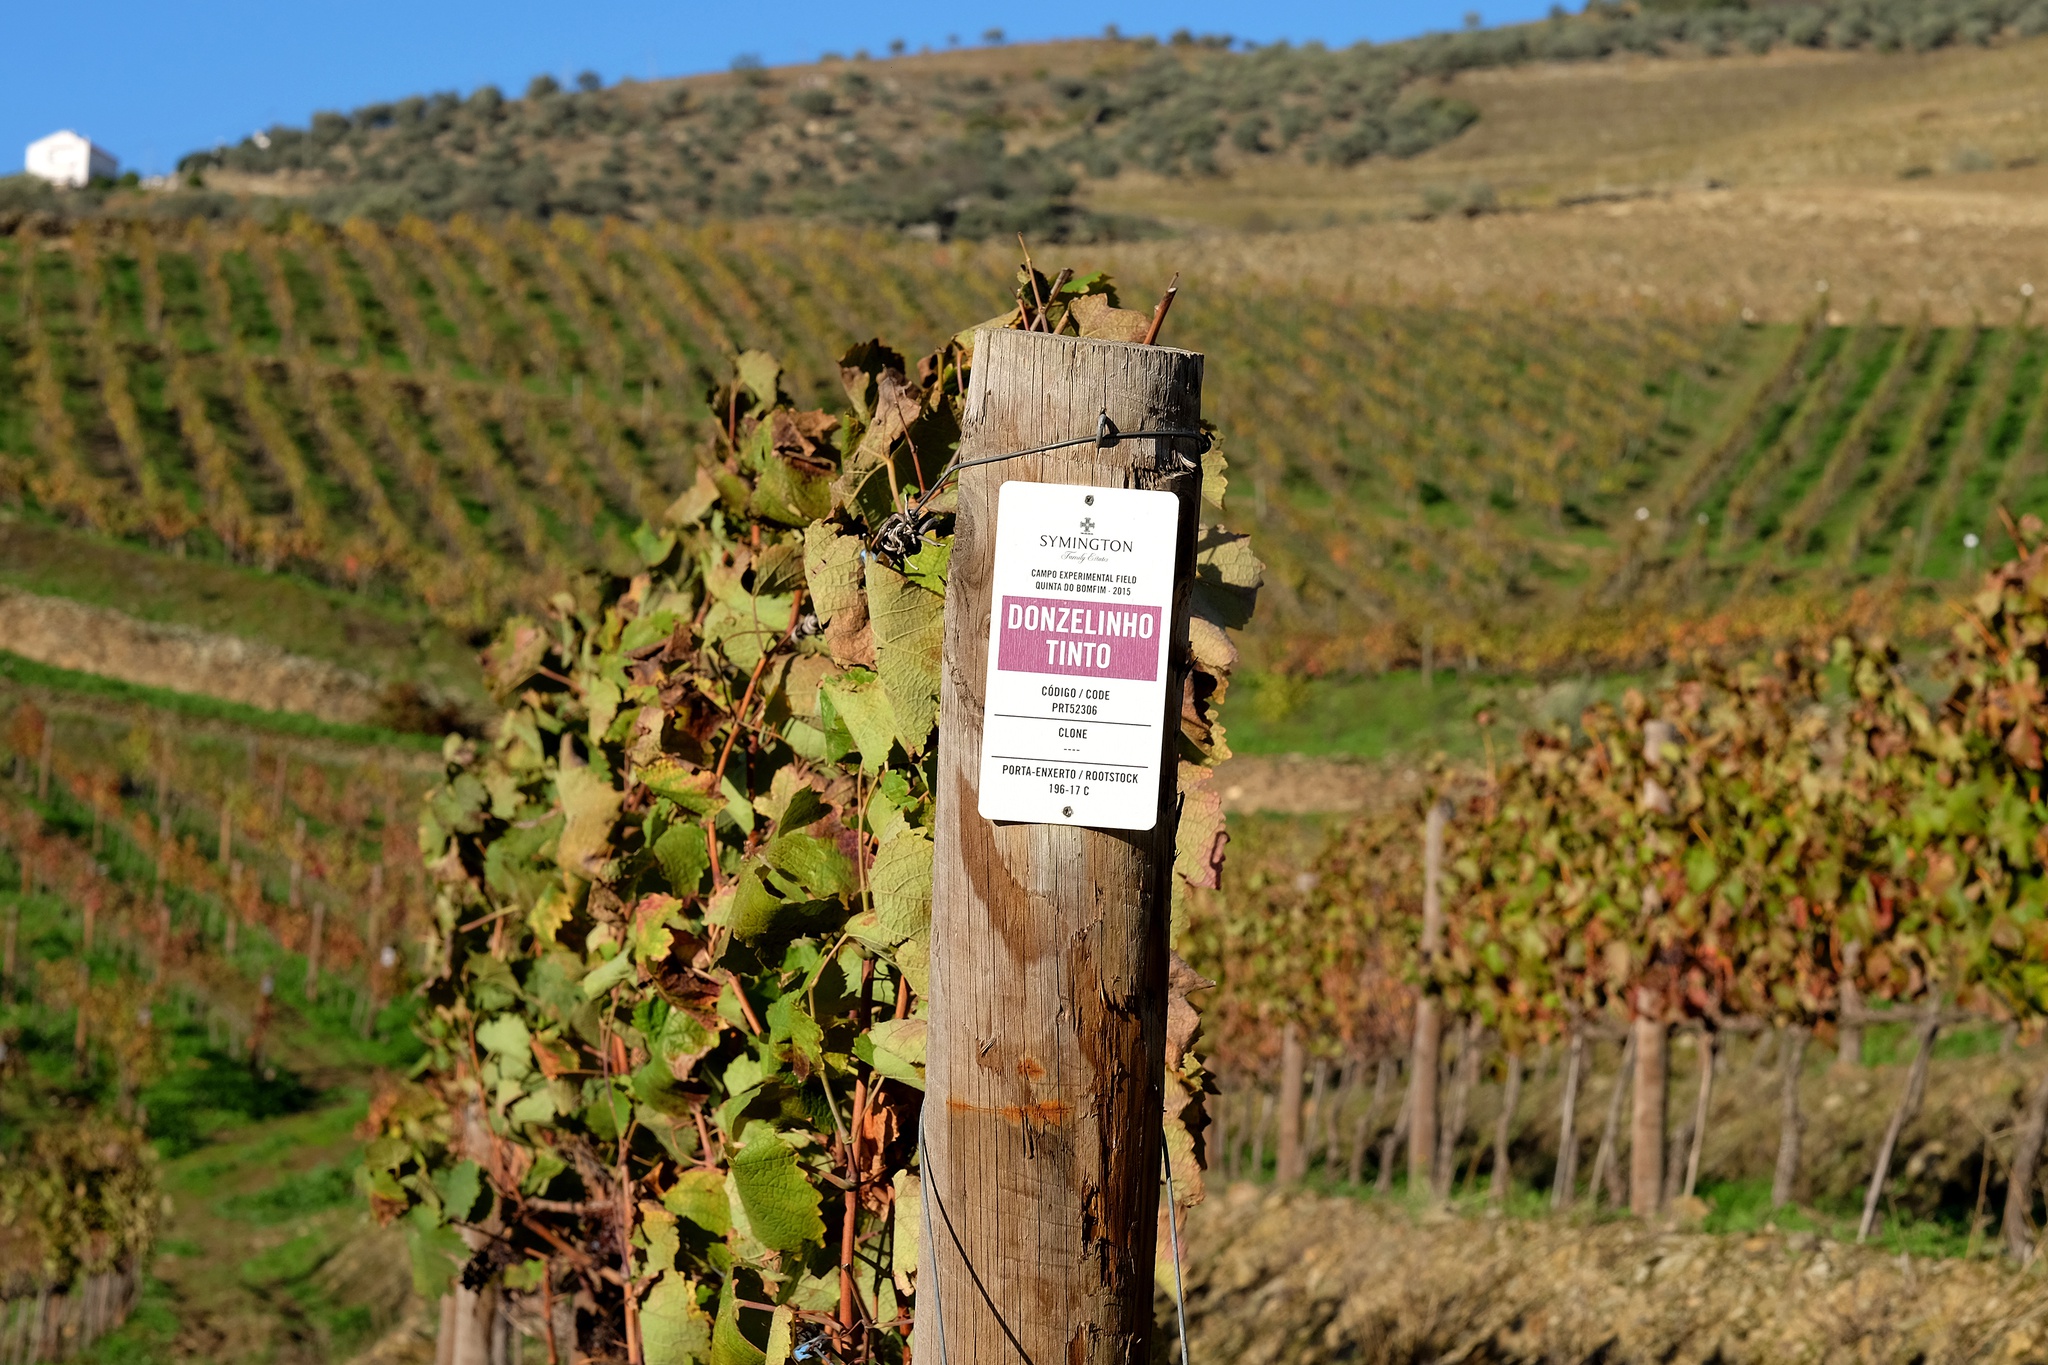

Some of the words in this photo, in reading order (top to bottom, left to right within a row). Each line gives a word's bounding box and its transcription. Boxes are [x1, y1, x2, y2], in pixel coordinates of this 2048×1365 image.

[1040, 534, 1133, 553] SYMINGTON
[1061, 550, 1087, 564] Family
[1031, 568, 1057, 579] CAMPO
[1059, 570, 1114, 583] EXPERIMENTAL
[1115, 574, 1137, 584] FIELD
[1035, 581, 1062, 591] QUINTA
[1063, 583, 1074, 592] DO
[1076, 584, 1107, 594] BOMFIM
[1112, 586, 1131, 596] 2015
[1008, 603, 1154, 639] DONZELINHO
[1046, 639, 1111, 669] TINTO
[1041, 684, 1076, 698] CÓDIGO
[1078, 688, 1084, 699] /
[1085, 689, 1110, 700] CODE
[1052, 702, 1098, 715] PRT52306
[1058, 727, 1088, 739] CLONE
[1002, 764, 1076, 780] PORTA-ENXERTO
[1078, 770, 1084, 780] /
[1085, 770, 1139, 784] ROOTSTOCK
[1049, 783, 1081, 795] 196-17
[1083, 785, 1090, 796] C
